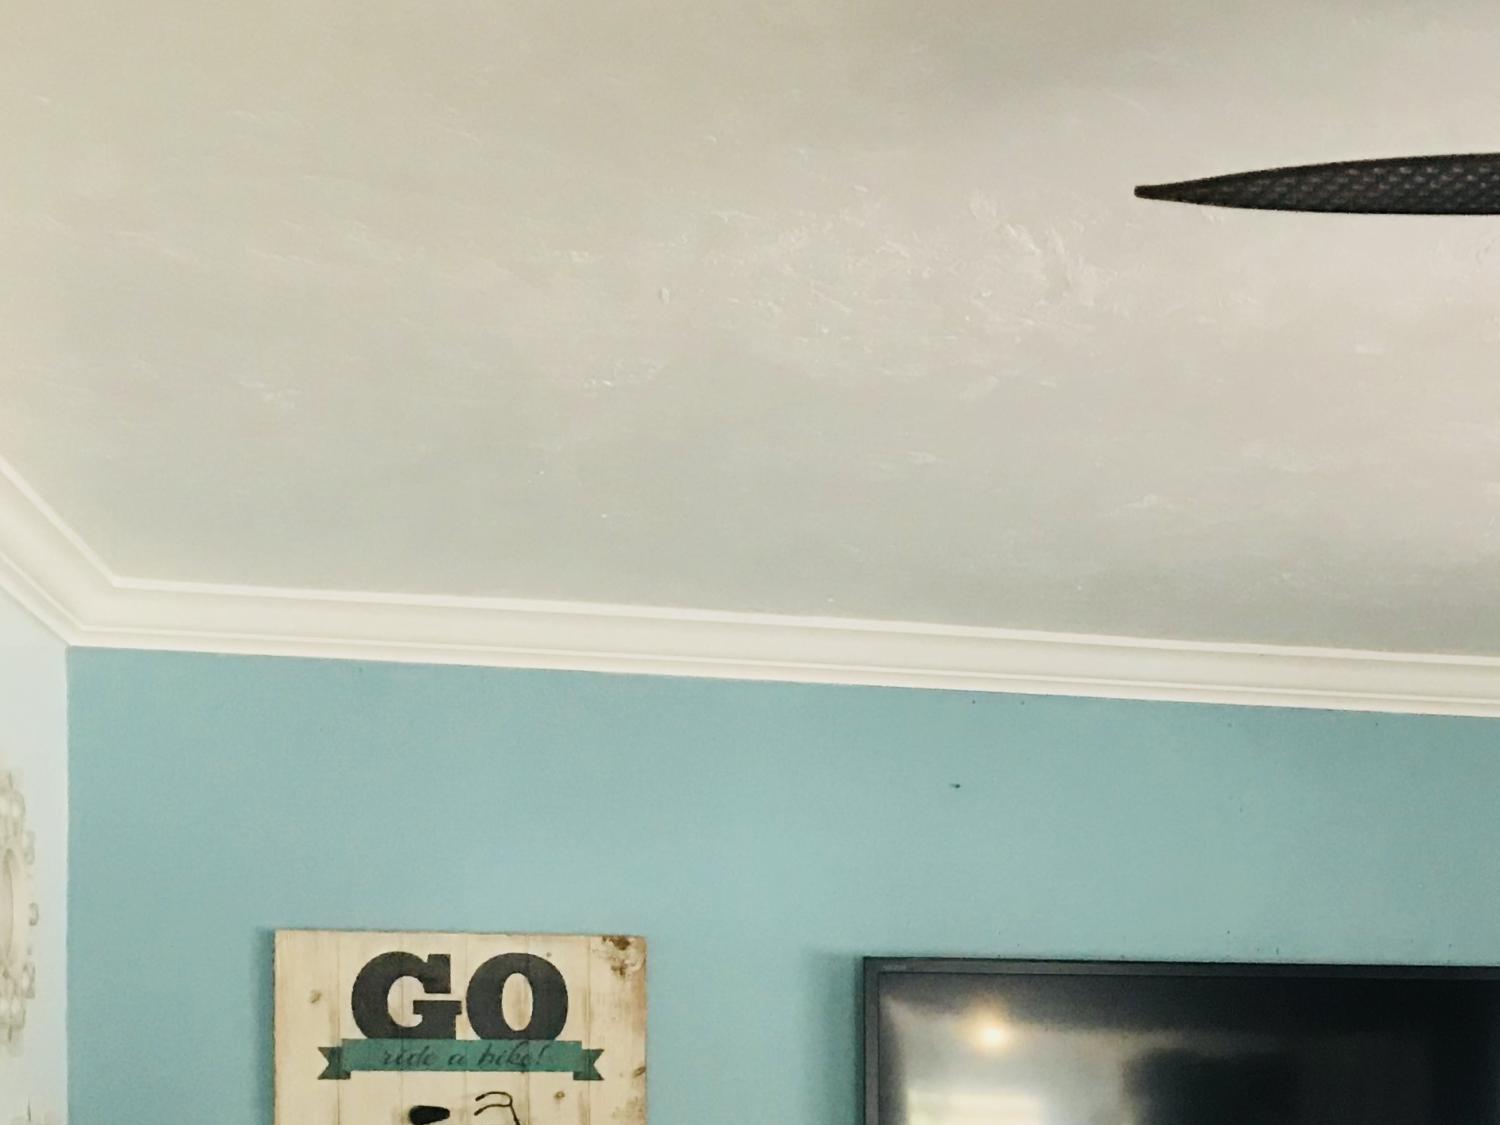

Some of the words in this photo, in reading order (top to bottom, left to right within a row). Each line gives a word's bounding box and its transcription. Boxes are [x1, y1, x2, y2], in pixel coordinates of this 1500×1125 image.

[351, 951, 568, 1040] GO
[383, 1044, 435, 1067] ride
[447, 1052, 465, 1066] a
[477, 1041, 549, 1068] bike!
